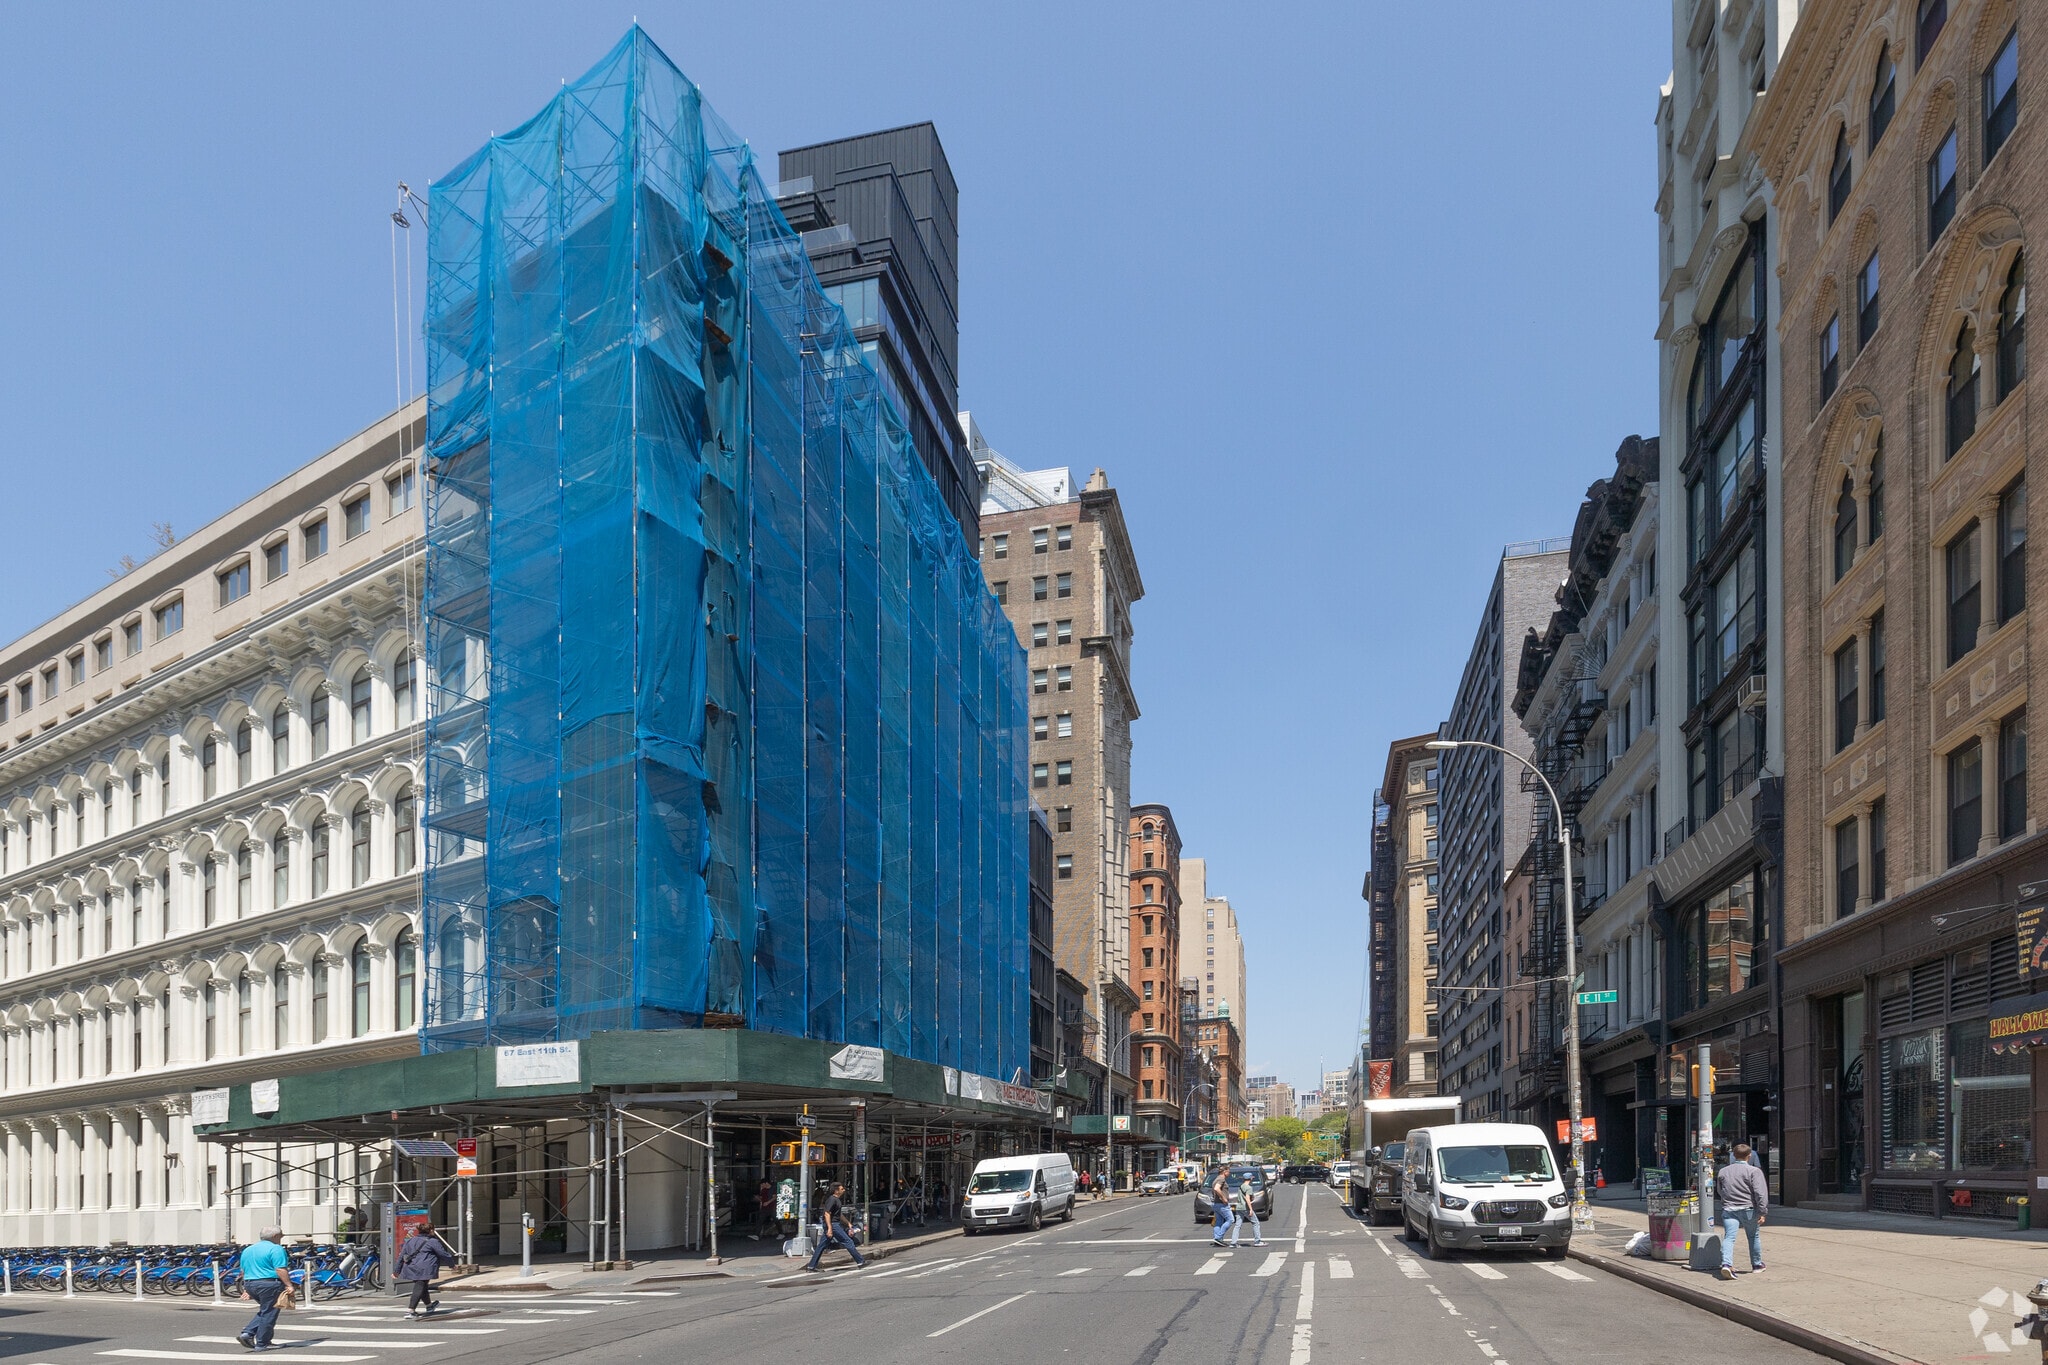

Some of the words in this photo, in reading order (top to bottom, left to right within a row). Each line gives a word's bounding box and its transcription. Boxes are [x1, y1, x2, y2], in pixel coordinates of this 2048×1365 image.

[1584, 994, 1590, 1003] E
[1594, 993, 1601, 1002] 11
[517, 1048, 536, 1056] East
[1371, 1064, 1390, 1090] STRAND
[1002, 1083, 1037, 1105] METROPOLIS
